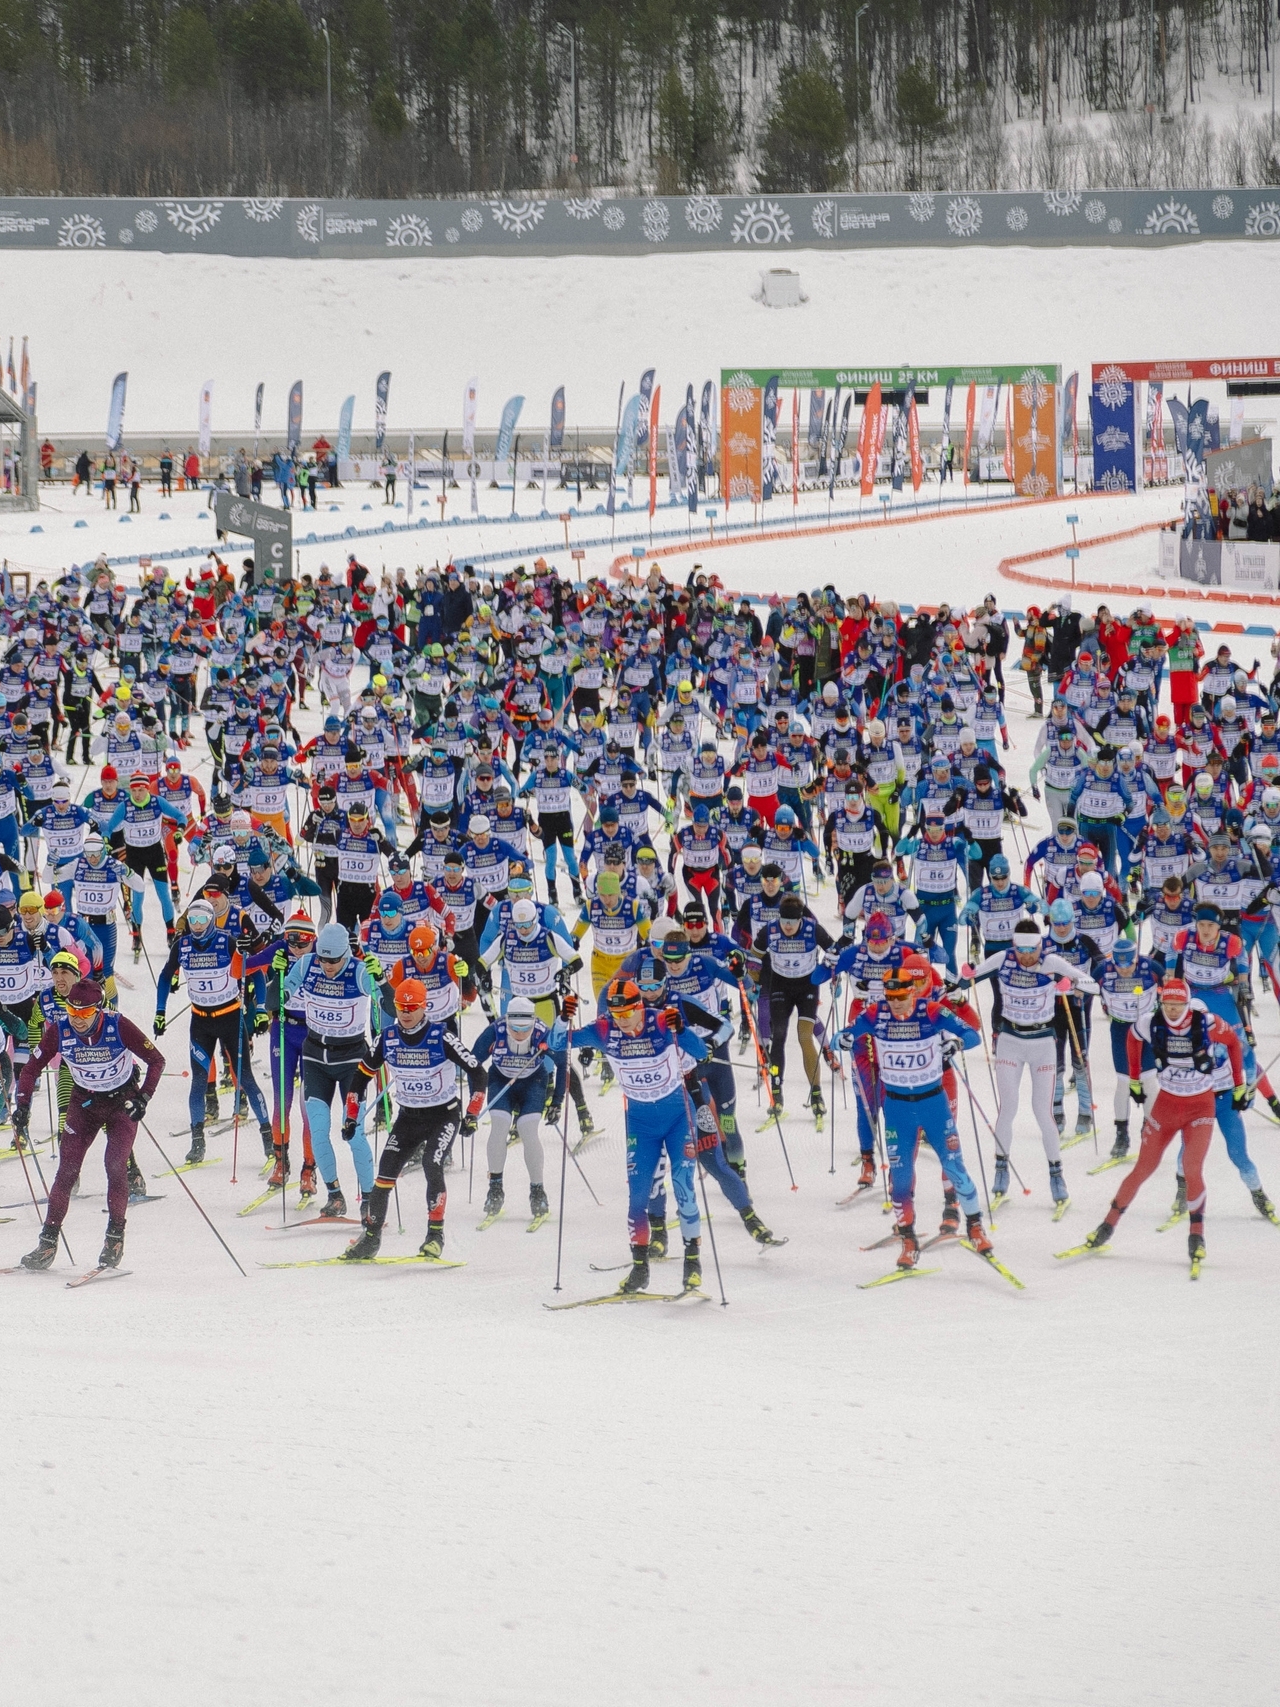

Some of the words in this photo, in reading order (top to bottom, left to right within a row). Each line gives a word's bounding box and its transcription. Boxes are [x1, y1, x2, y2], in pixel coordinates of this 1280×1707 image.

[1210, 361, 1268, 376] ФИНИШ
[836, 371, 893, 384] ФИНИШ
[917, 370, 938, 383] КМ
[117, 758, 136, 766] 279
[265, 795, 277, 803] 89
[137, 828, 155, 836] 128
[56, 838, 75, 846] 152
[346, 861, 364, 869] 130
[84, 892, 104, 902] 103
[998, 921, 1011, 930] 61
[605, 937, 621, 945] 83
[519, 972, 536, 982] 58
[198, 980, 213, 991] 31
[315, 981, 345, 990] ЛЫЖНЫЙ
[314, 1009, 342, 1021] 1485
[75, 1049, 111, 1059] ЛЫЖНЫЙ
[397, 1051, 430, 1060] ЛЫЖНЫЙ
[397, 1058, 431, 1066] МАРАФОН
[888, 1054, 926, 1067] 1470
[79, 1066, 118, 1080] 1473
[628, 1072, 662, 1085] 1486
[402, 1081, 433, 1092] 1498
